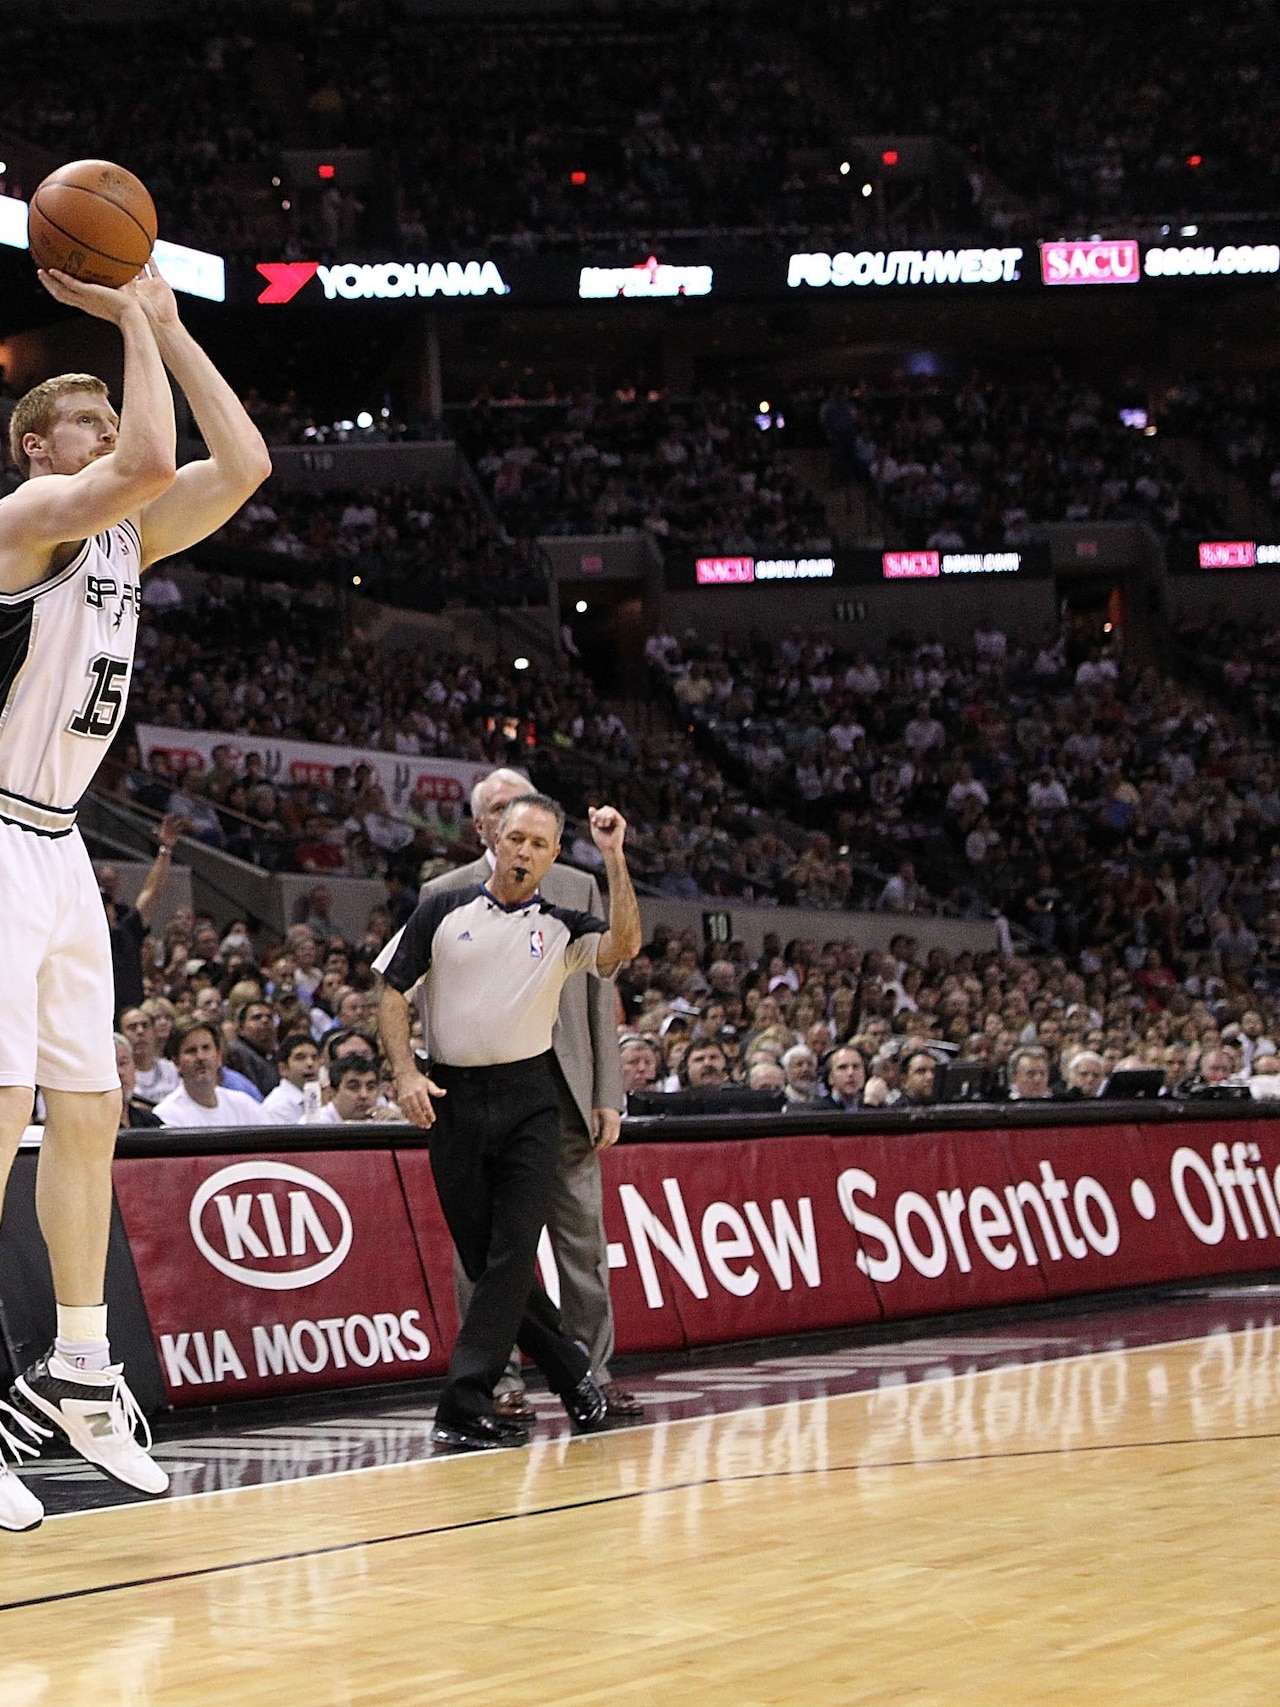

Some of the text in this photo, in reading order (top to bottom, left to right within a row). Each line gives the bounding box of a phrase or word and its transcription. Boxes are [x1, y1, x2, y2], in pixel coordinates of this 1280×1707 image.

[316, 261, 506, 299] YOKOHAMA
[1046, 247, 1134, 278] SACU
[65, 652, 129, 738] 15
[213, 1190, 334, 1260] KIA
[836, 1160, 1120, 1283] Sorento
[160, 1309, 431, 1387] KIA MOTORS
